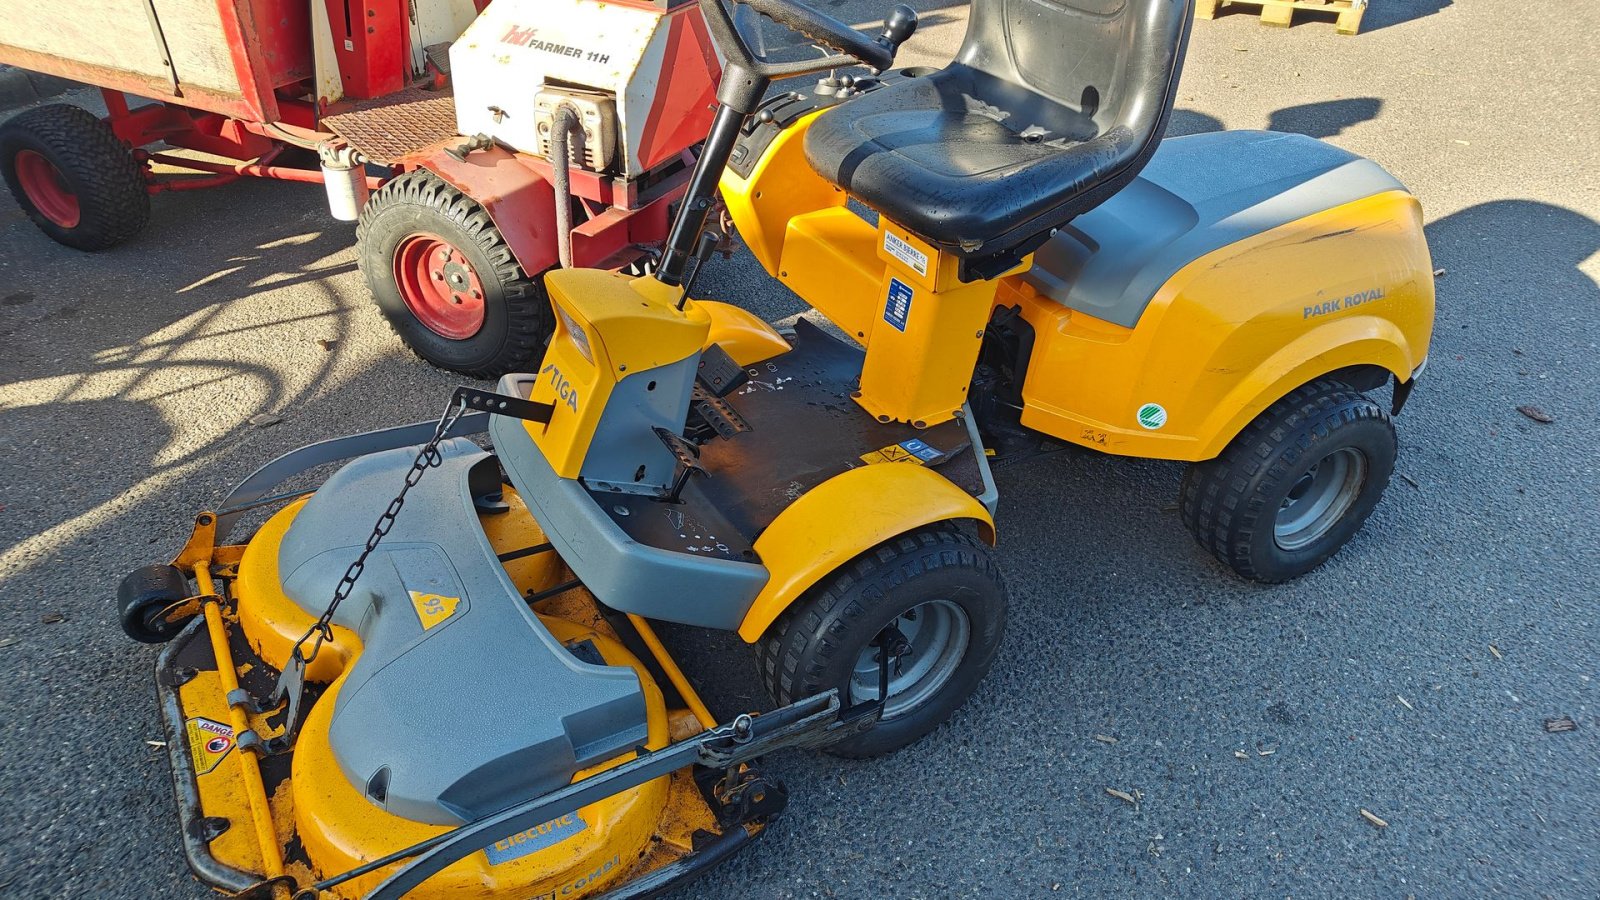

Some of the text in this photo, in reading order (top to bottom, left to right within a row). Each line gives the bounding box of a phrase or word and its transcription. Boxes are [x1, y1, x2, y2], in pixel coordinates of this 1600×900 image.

[528, 39, 610, 64] FARMER 11H
[1303, 287, 1384, 320] PARK ROYAL
[423, 598, 444, 615] 95
[494, 814, 573, 852] Electric
[561, 854, 620, 895] COMBI
